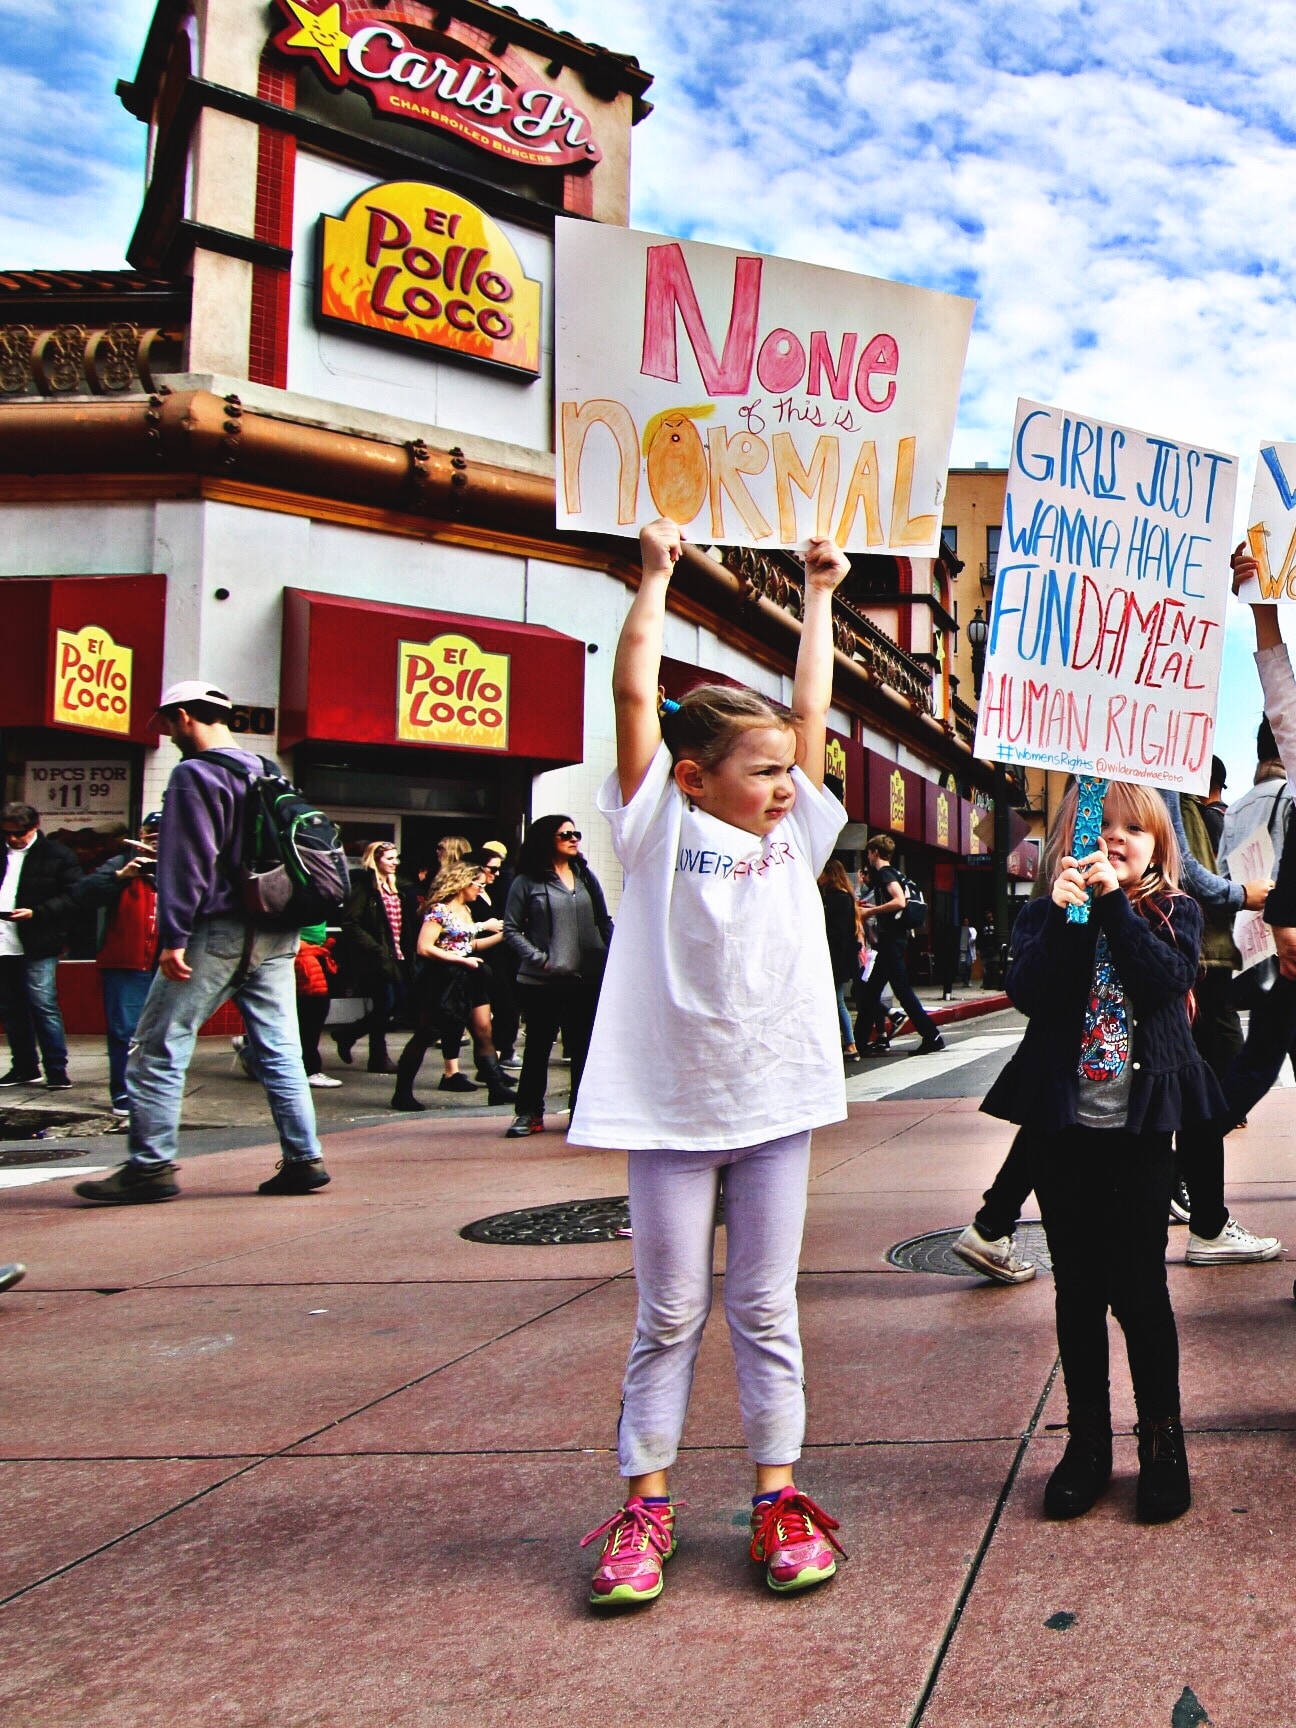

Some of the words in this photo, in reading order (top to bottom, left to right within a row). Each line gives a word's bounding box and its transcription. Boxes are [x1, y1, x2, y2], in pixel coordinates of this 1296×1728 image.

[347, 26, 512, 115] Carl's
[513, 90, 595, 153] Jr.
[389, 95, 490, 145] CHARBROILED
[492, 141, 553, 163] BURGERS
[424, 207, 462, 239] El
[365, 205, 513, 302] Pollo
[371, 265, 513, 339] Loco
[738, 399, 766, 434] of
[773, 397, 827, 429] this
[834, 405, 862, 433] is
[1015, 410, 1126, 500] GIRLS
[1137, 437, 1232, 524] JUST
[1006, 493, 1119, 569] WANNA
[1126, 516, 1211, 598] HAVE
[61, 642, 127, 691] Pollo
[88, 639, 104, 655] El
[443, 648, 468, 665] El
[63, 677, 127, 714] Loco
[405, 654, 502, 703] Pollo
[409, 691, 503, 728] Loco
[984, 672, 1092, 752] HUMAN
[1106, 694, 1214, 773] RIGHTS
[31, 767, 47, 781] 10
[50, 767, 85, 781] PCS
[90, 767, 126, 780] FOR
[996, 743, 1093, 771] #WomensRights
[675, 849, 733, 880] OVER
